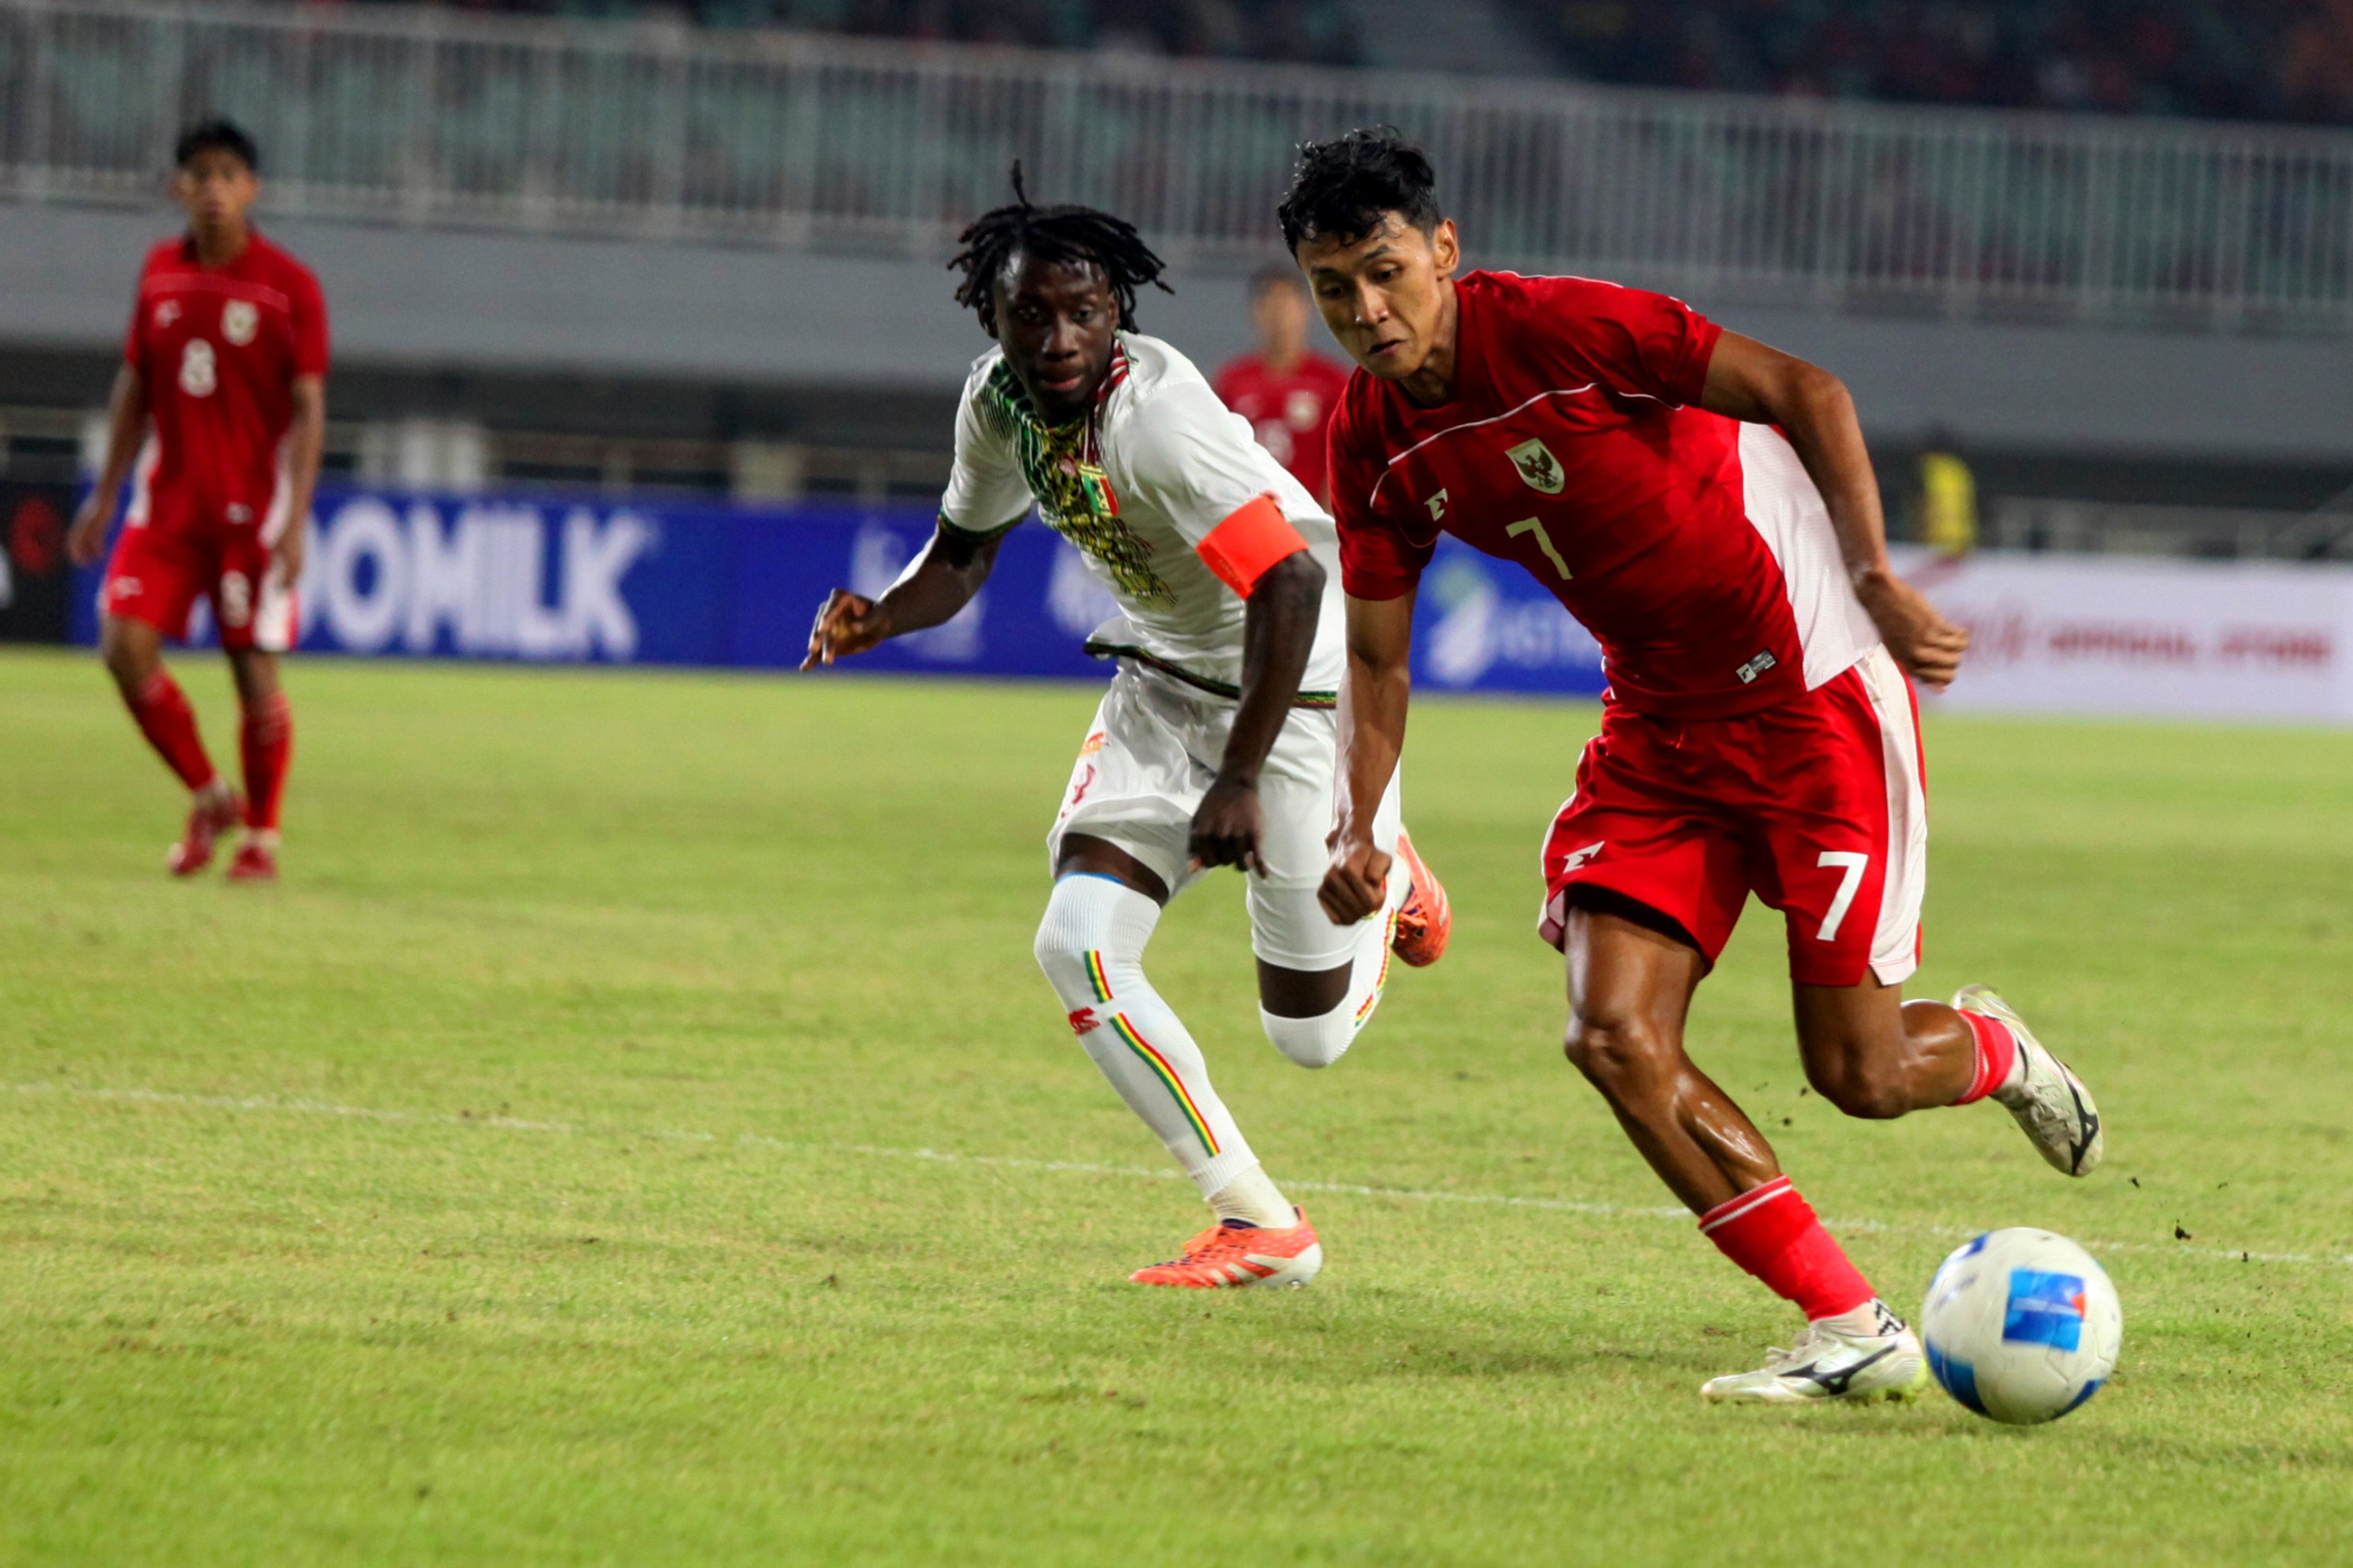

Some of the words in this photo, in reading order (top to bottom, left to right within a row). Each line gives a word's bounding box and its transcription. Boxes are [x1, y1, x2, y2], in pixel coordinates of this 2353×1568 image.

[178, 337, 217, 397] 8
[300, 497, 656, 655] OMILK
[1505, 516, 1574, 581] 7
[1816, 850, 1870, 941] 7
